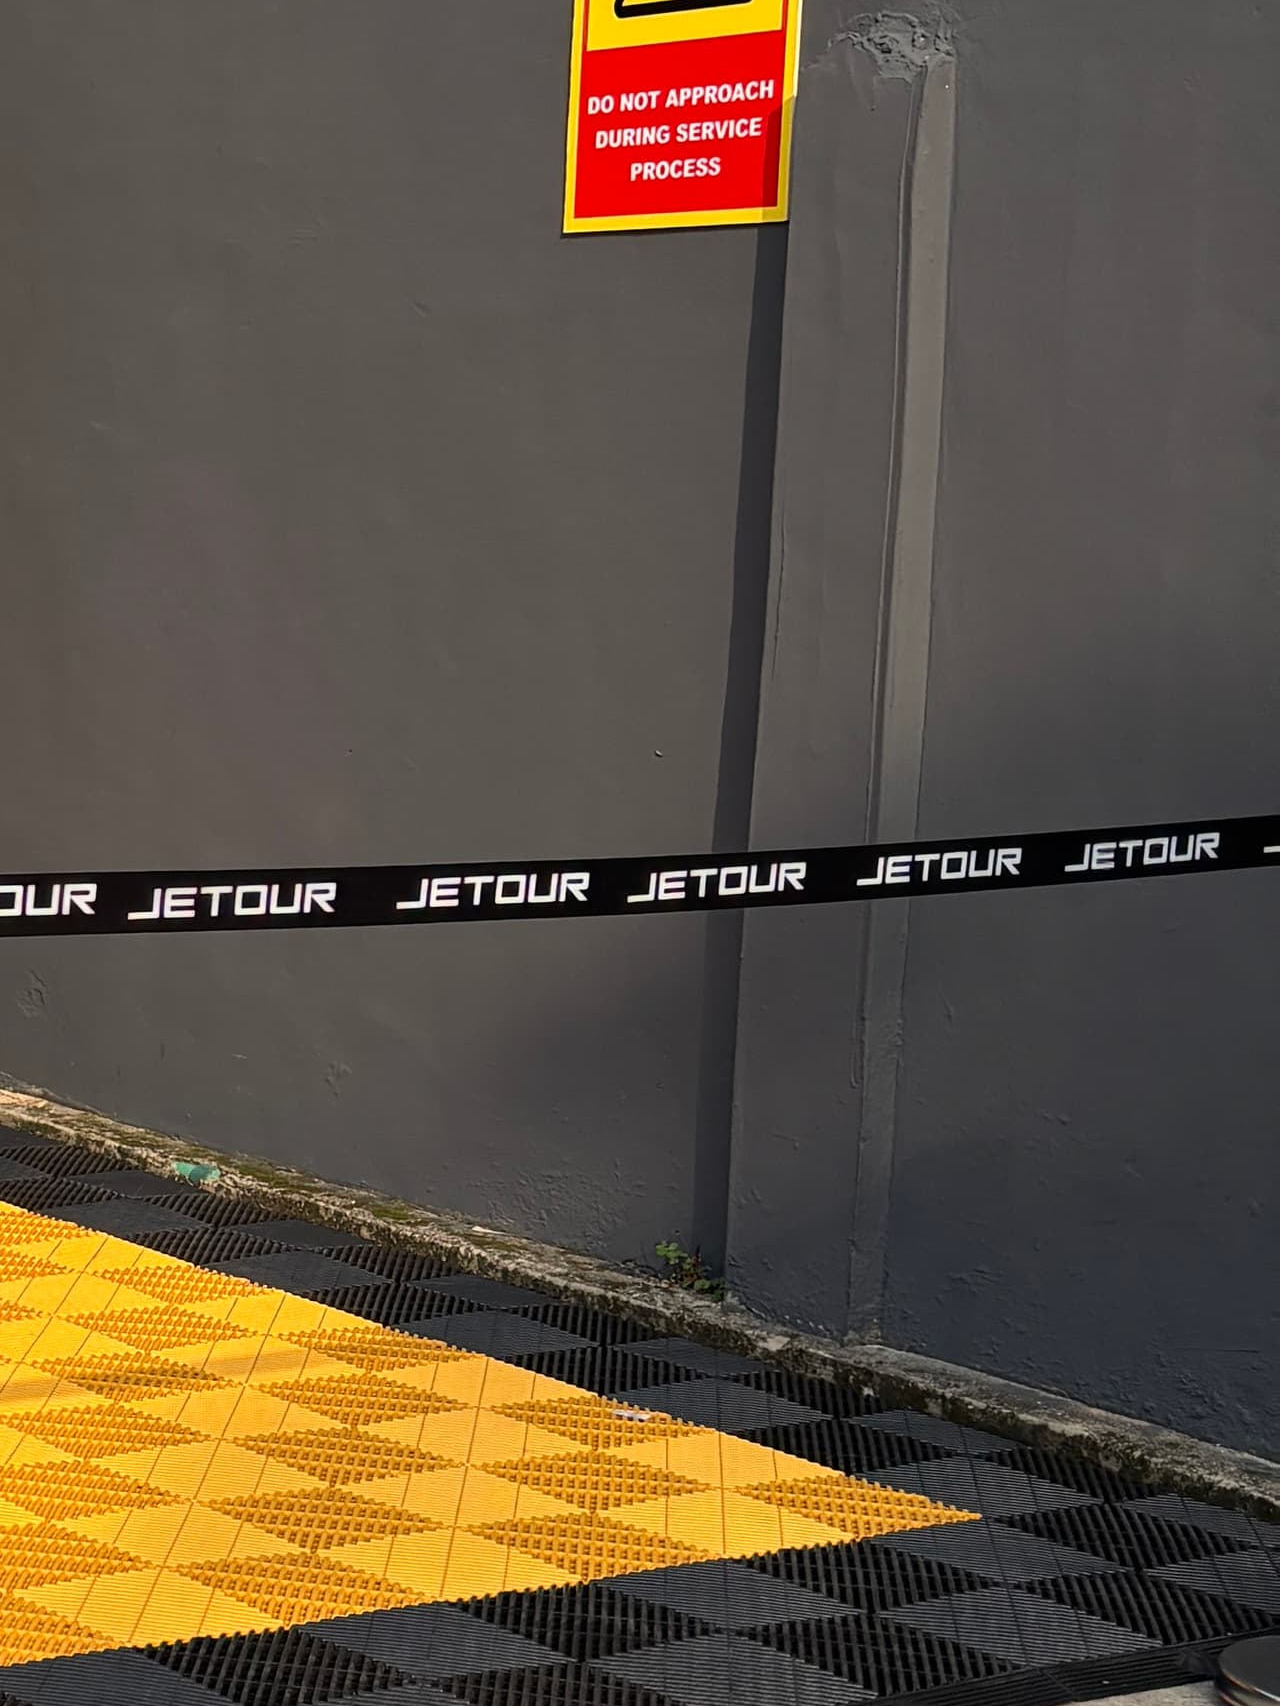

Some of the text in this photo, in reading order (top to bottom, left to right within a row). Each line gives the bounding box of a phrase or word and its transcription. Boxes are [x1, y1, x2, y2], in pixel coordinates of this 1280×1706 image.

[587, 79, 775, 115] DO NOT APPROACH
[595, 117, 763, 149] DURING SERVICE
[630, 156, 722, 182] PROCESS
[127, 882, 337, 920] JETOUR
[396, 872, 590, 910] JETOUR
[627, 861, 807, 903] JETOUR
[856, 847, 1022, 886] JETOUR
[1064, 832, 1220, 872] JETOUR
